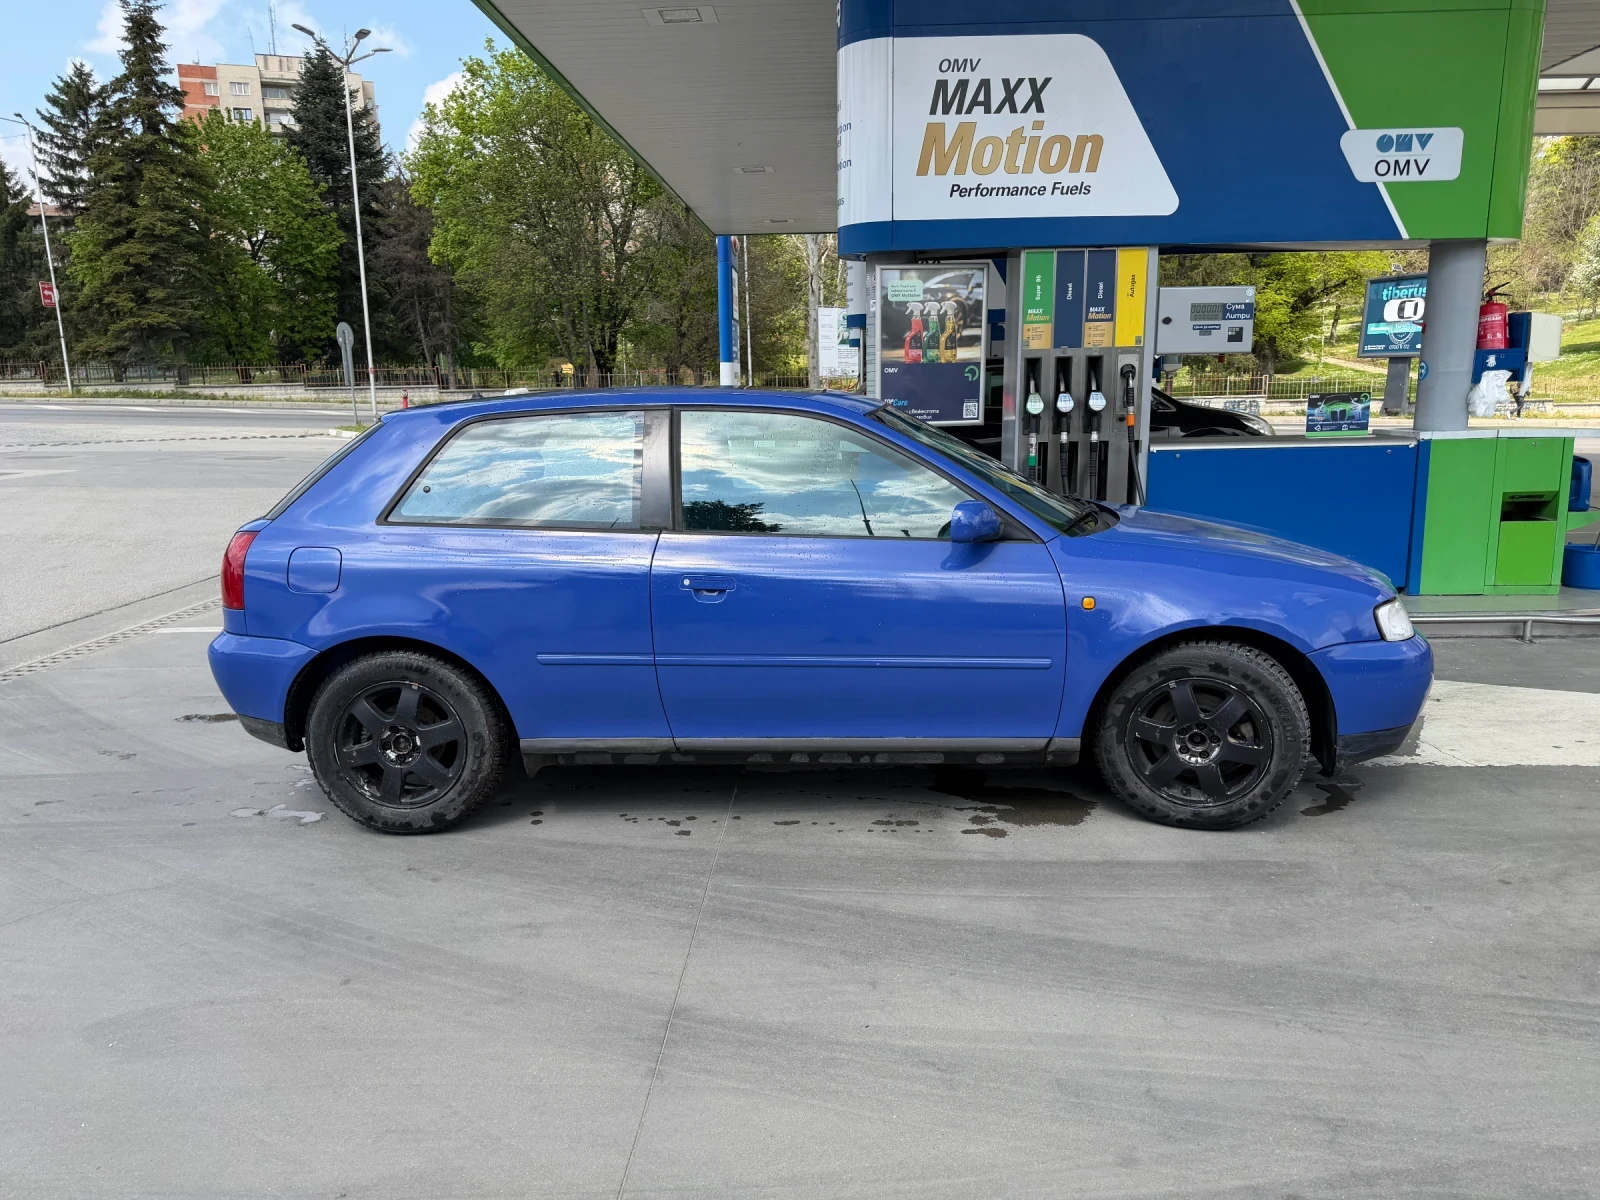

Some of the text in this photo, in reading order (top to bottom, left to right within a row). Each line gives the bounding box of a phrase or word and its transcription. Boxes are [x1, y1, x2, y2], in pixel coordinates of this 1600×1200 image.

[938, 58, 981, 74] OMV
[929, 77, 1053, 116] MAXX
[916, 120, 1104, 176] Motion
[1374, 158, 1430, 177] OMV
[949, 181, 1092, 198] Performance Fuels
[1026, 313, 1050, 321] Motion
[1087, 312, 1112, 320] Motion
